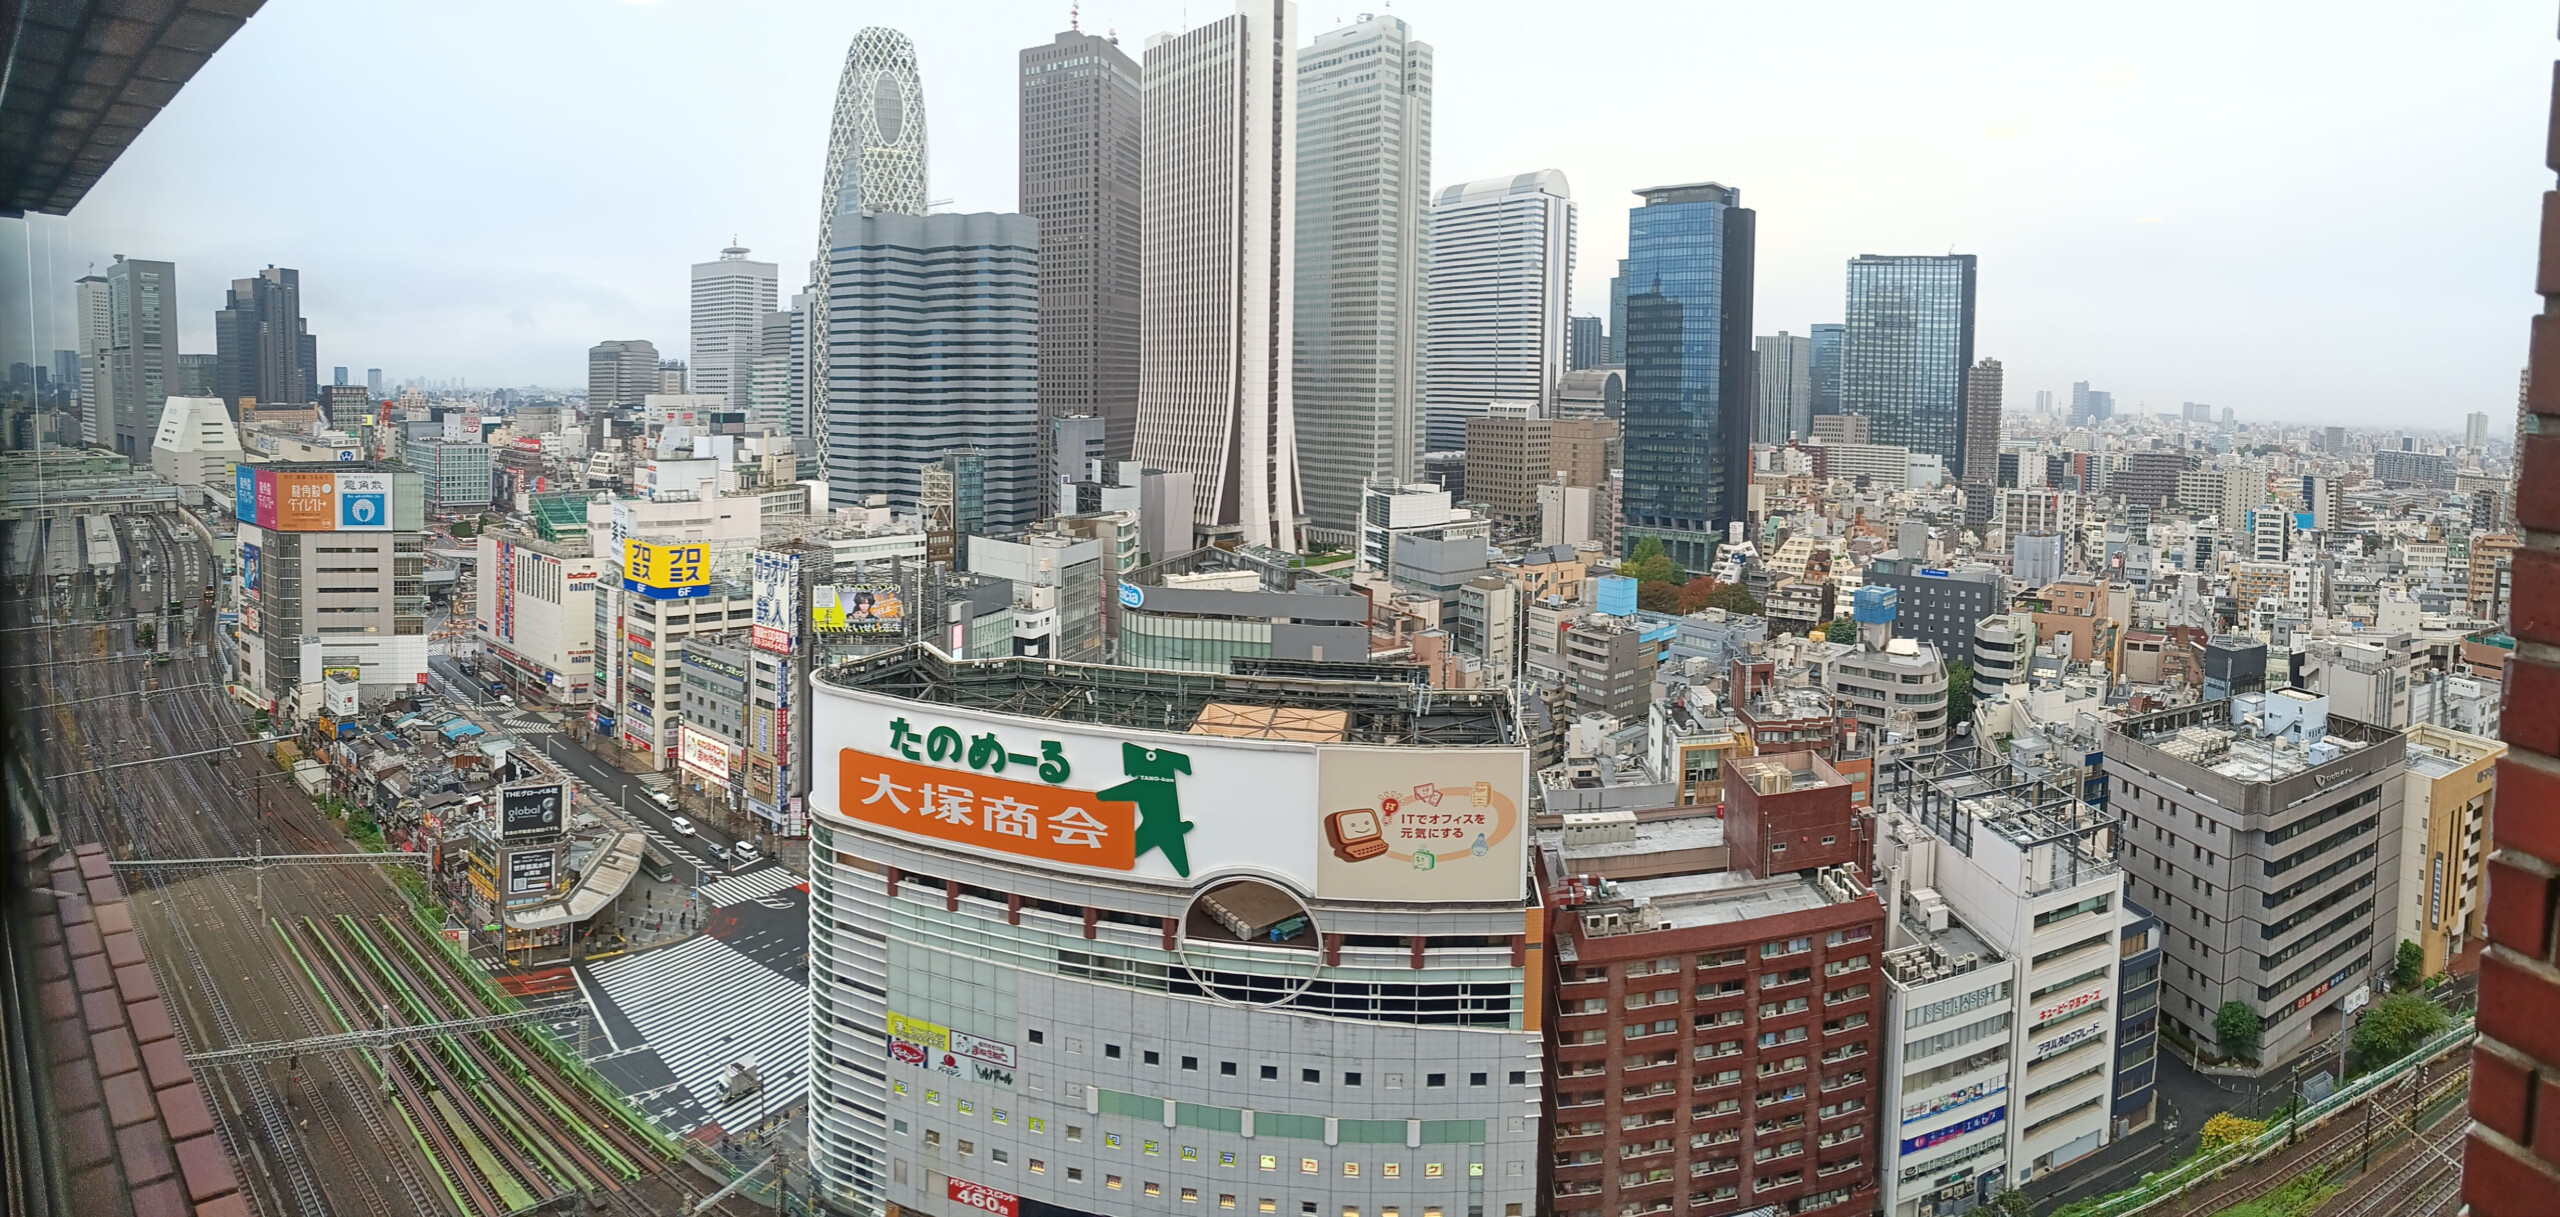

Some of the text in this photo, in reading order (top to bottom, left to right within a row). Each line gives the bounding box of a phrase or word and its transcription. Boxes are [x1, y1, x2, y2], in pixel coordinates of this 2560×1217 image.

[755, 550, 787, 588] カラオケ
[569, 582, 595, 591] ODAKYU
[637, 583, 646, 592] 6F
[678, 587, 692, 597] 6F
[766, 583, 775, 601] の
[889, 716, 1071, 784] たのめーる
[508, 804, 541, 822] global
[860, 772, 1109, 849] 大塚商会
[1401, 813, 1486, 825] ITでオフィスを
[1400, 827, 1464, 839] 元気にする
